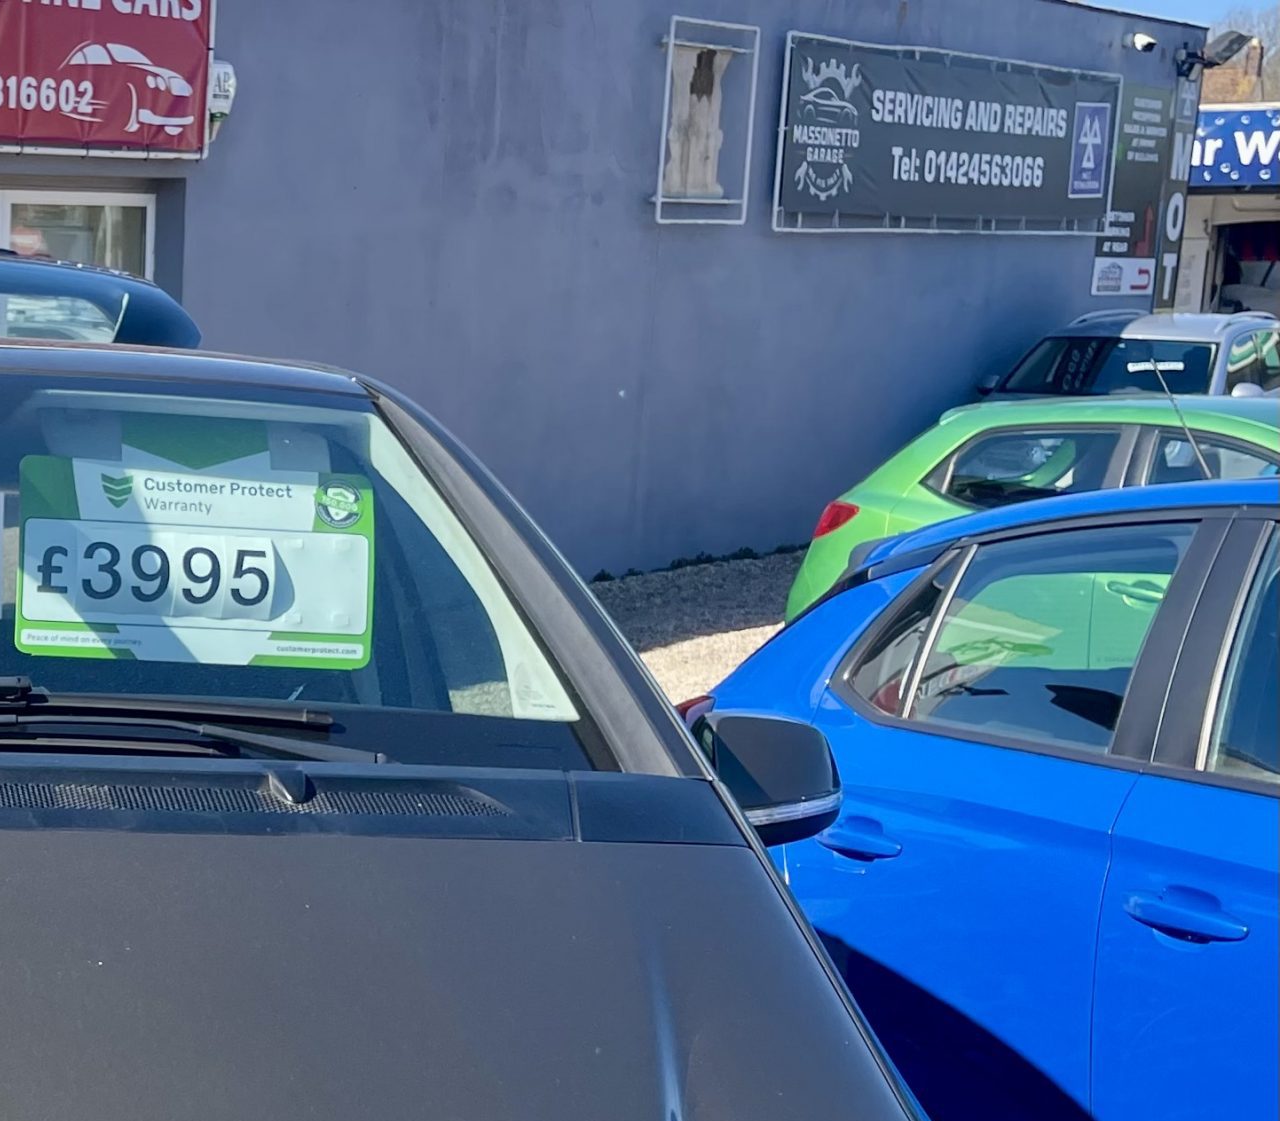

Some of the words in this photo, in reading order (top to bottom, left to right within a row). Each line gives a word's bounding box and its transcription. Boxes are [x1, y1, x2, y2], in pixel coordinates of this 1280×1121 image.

[871, 89, 963, 131] SERVICING
[965, 100, 1002, 133] AND
[1004, 104, 1068, 138] REPAIRS
[792, 124, 860, 148] MASSONETTO
[1233, 130, 1280, 166] W
[806, 147, 845, 163] GARAGE
[891, 146, 921, 182] Tel:
[923, 149, 1045, 188] 01424563066
[143, 476, 226, 496] Customer
[230, 482, 293, 499] Protect
[143, 497, 213, 516] Warranty
[36, 541, 270, 607] £3995
